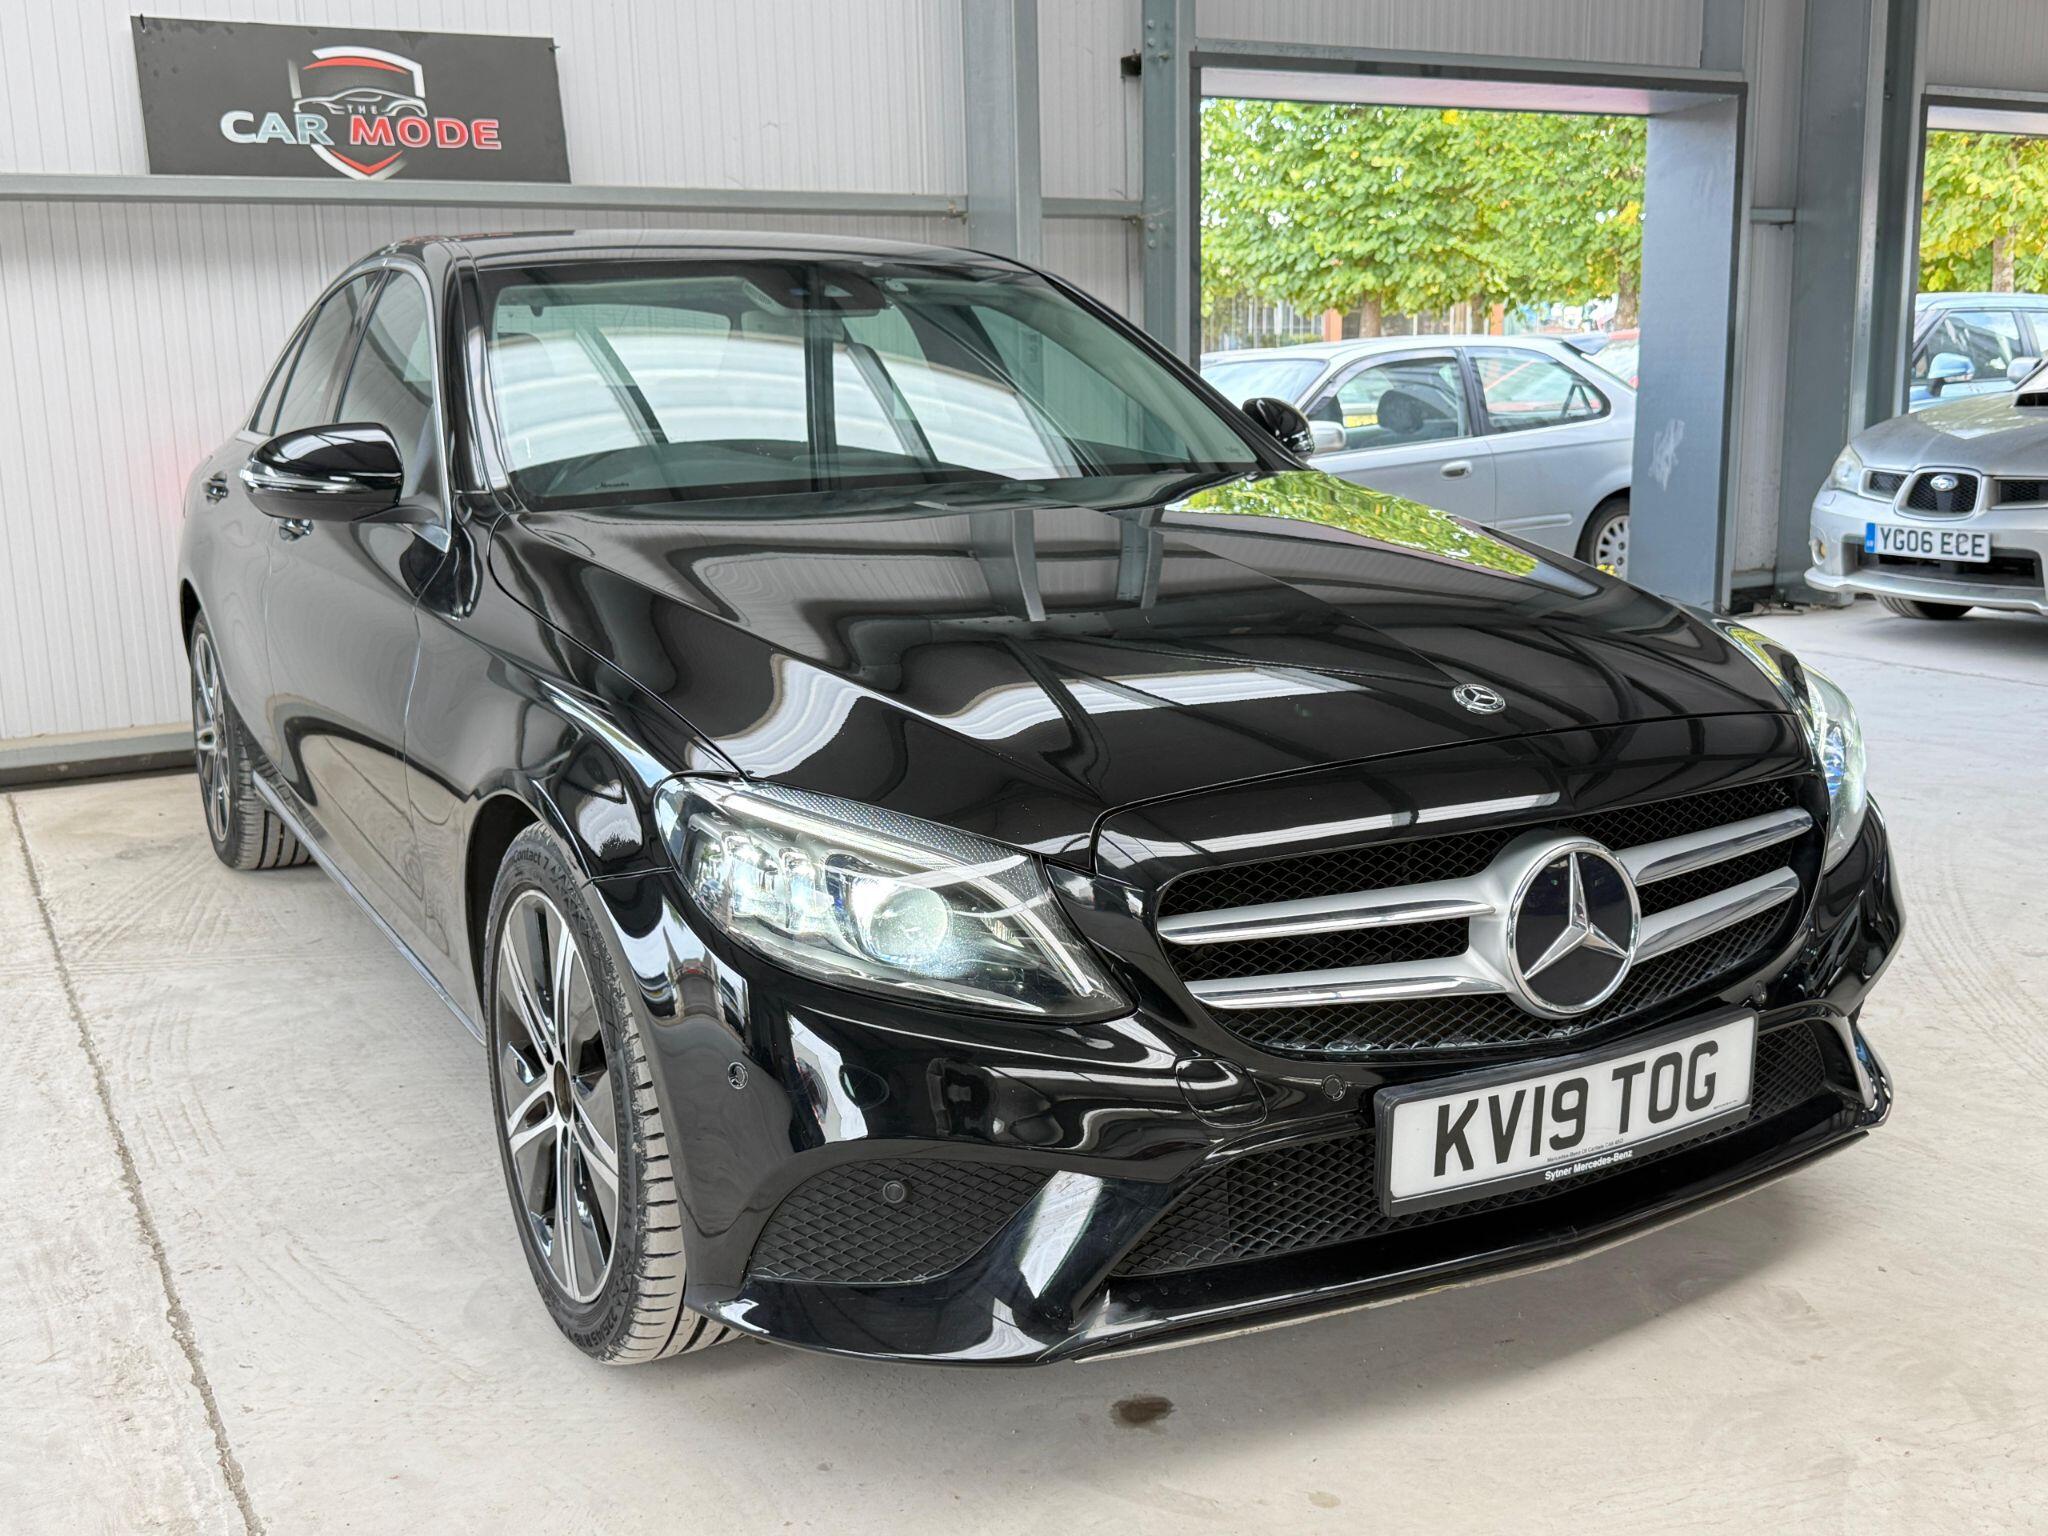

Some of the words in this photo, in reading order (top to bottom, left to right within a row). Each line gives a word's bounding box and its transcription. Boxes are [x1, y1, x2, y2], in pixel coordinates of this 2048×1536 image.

[347, 104, 378, 114] THE
[219, 110, 335, 146] CAR
[349, 115, 502, 150] MODE
[1880, 527, 1933, 553] YG06
[1941, 532, 1985, 557] ECE
[1434, 1077, 1588, 1177] KV19
[1611, 1040, 1718, 1135] TOG
[1545, 1166, 1572, 1181] Sytner
[1573, 1150, 1633, 1173] Mercedes-Benz
